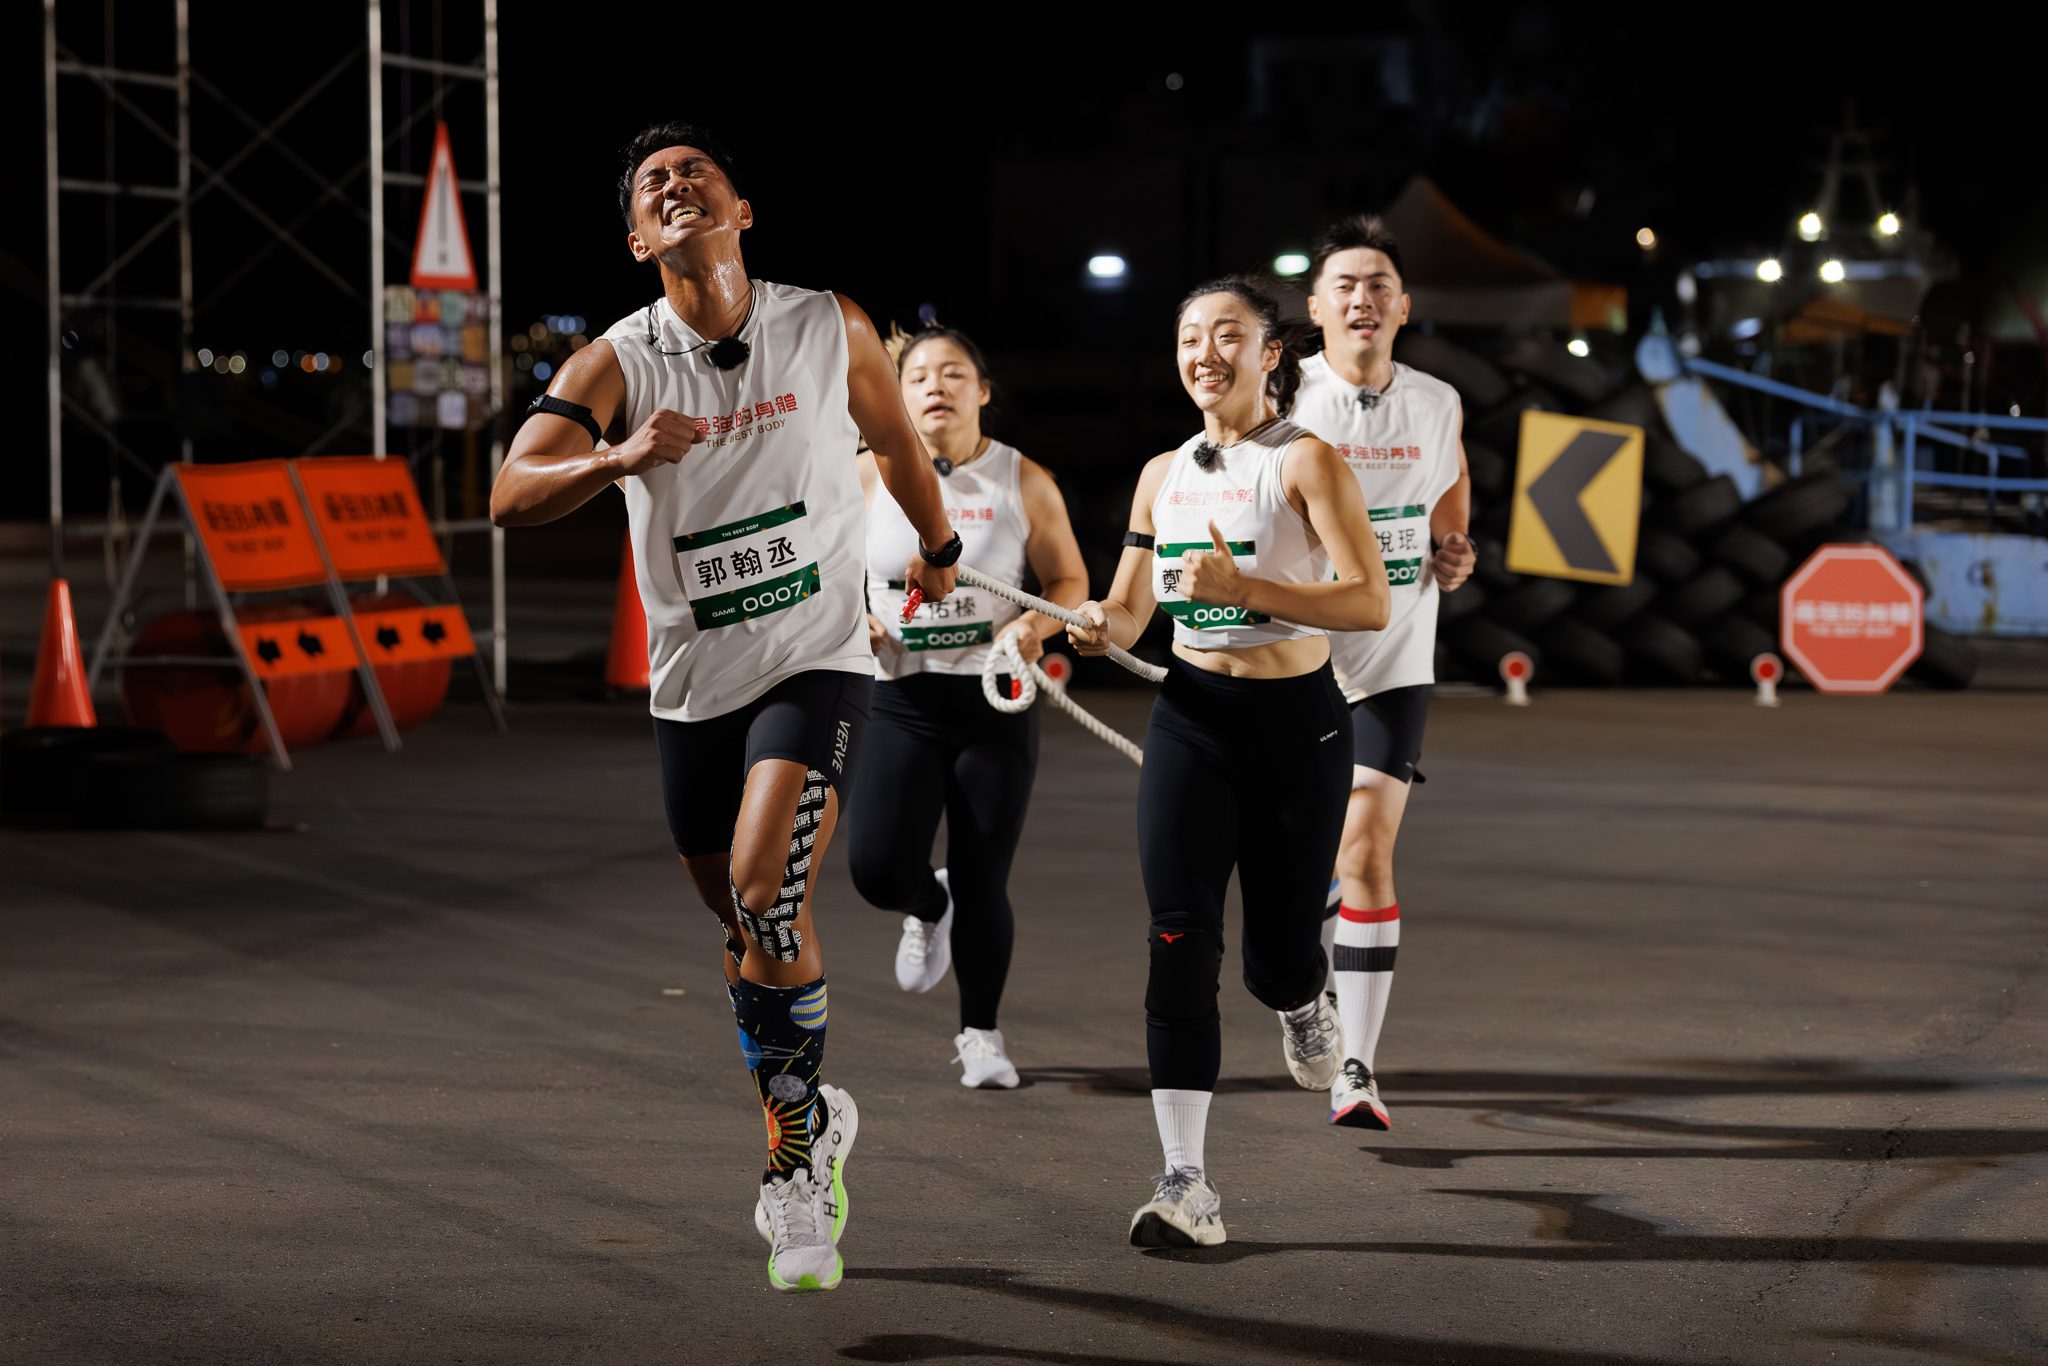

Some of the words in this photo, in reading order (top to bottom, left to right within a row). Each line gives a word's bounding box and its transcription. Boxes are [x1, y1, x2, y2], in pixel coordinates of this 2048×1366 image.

[694, 393, 798, 435] 最強的身體
[706, 439, 726, 448] THE
[730, 428, 753, 443] BEST
[757, 418, 786, 434] BODY
[733, 527, 745, 535] BEST
[695, 536, 797, 588] 郭翰丞
[1385, 566, 1420, 581] 007
[711, 607, 736, 618] GAME
[742, 580, 803, 612] 0007
[1194, 606, 1249, 622] 0007
[927, 629, 978, 646] 0007
[832, 720, 851, 775] VERVE
[824, 1106, 843, 1218] HYROX
